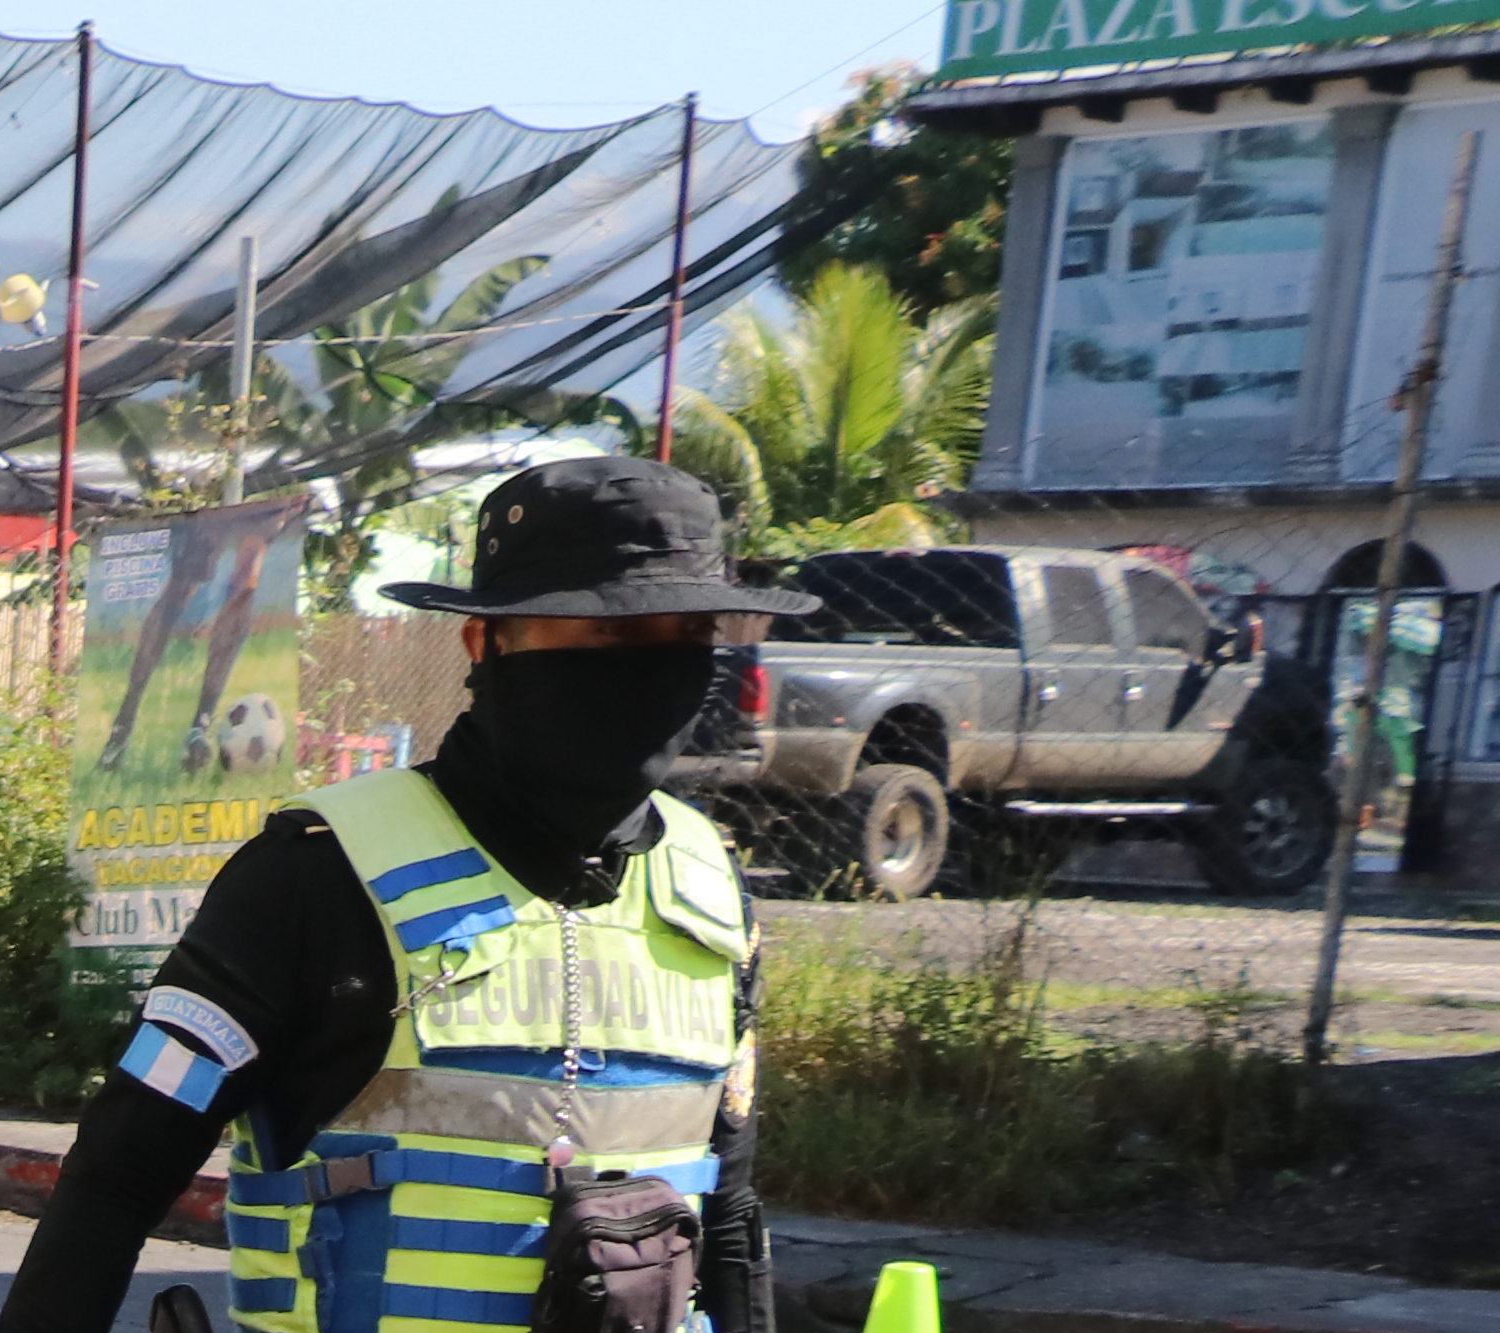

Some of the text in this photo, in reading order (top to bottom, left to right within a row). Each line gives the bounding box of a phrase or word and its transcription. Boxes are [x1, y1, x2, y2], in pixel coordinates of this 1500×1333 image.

[948, 0, 1198, 60] PLAZA
[74, 901, 139, 937] Club
[153, 994, 248, 1061] GUATEMALA
[653, 970, 725, 1045] VIAL
